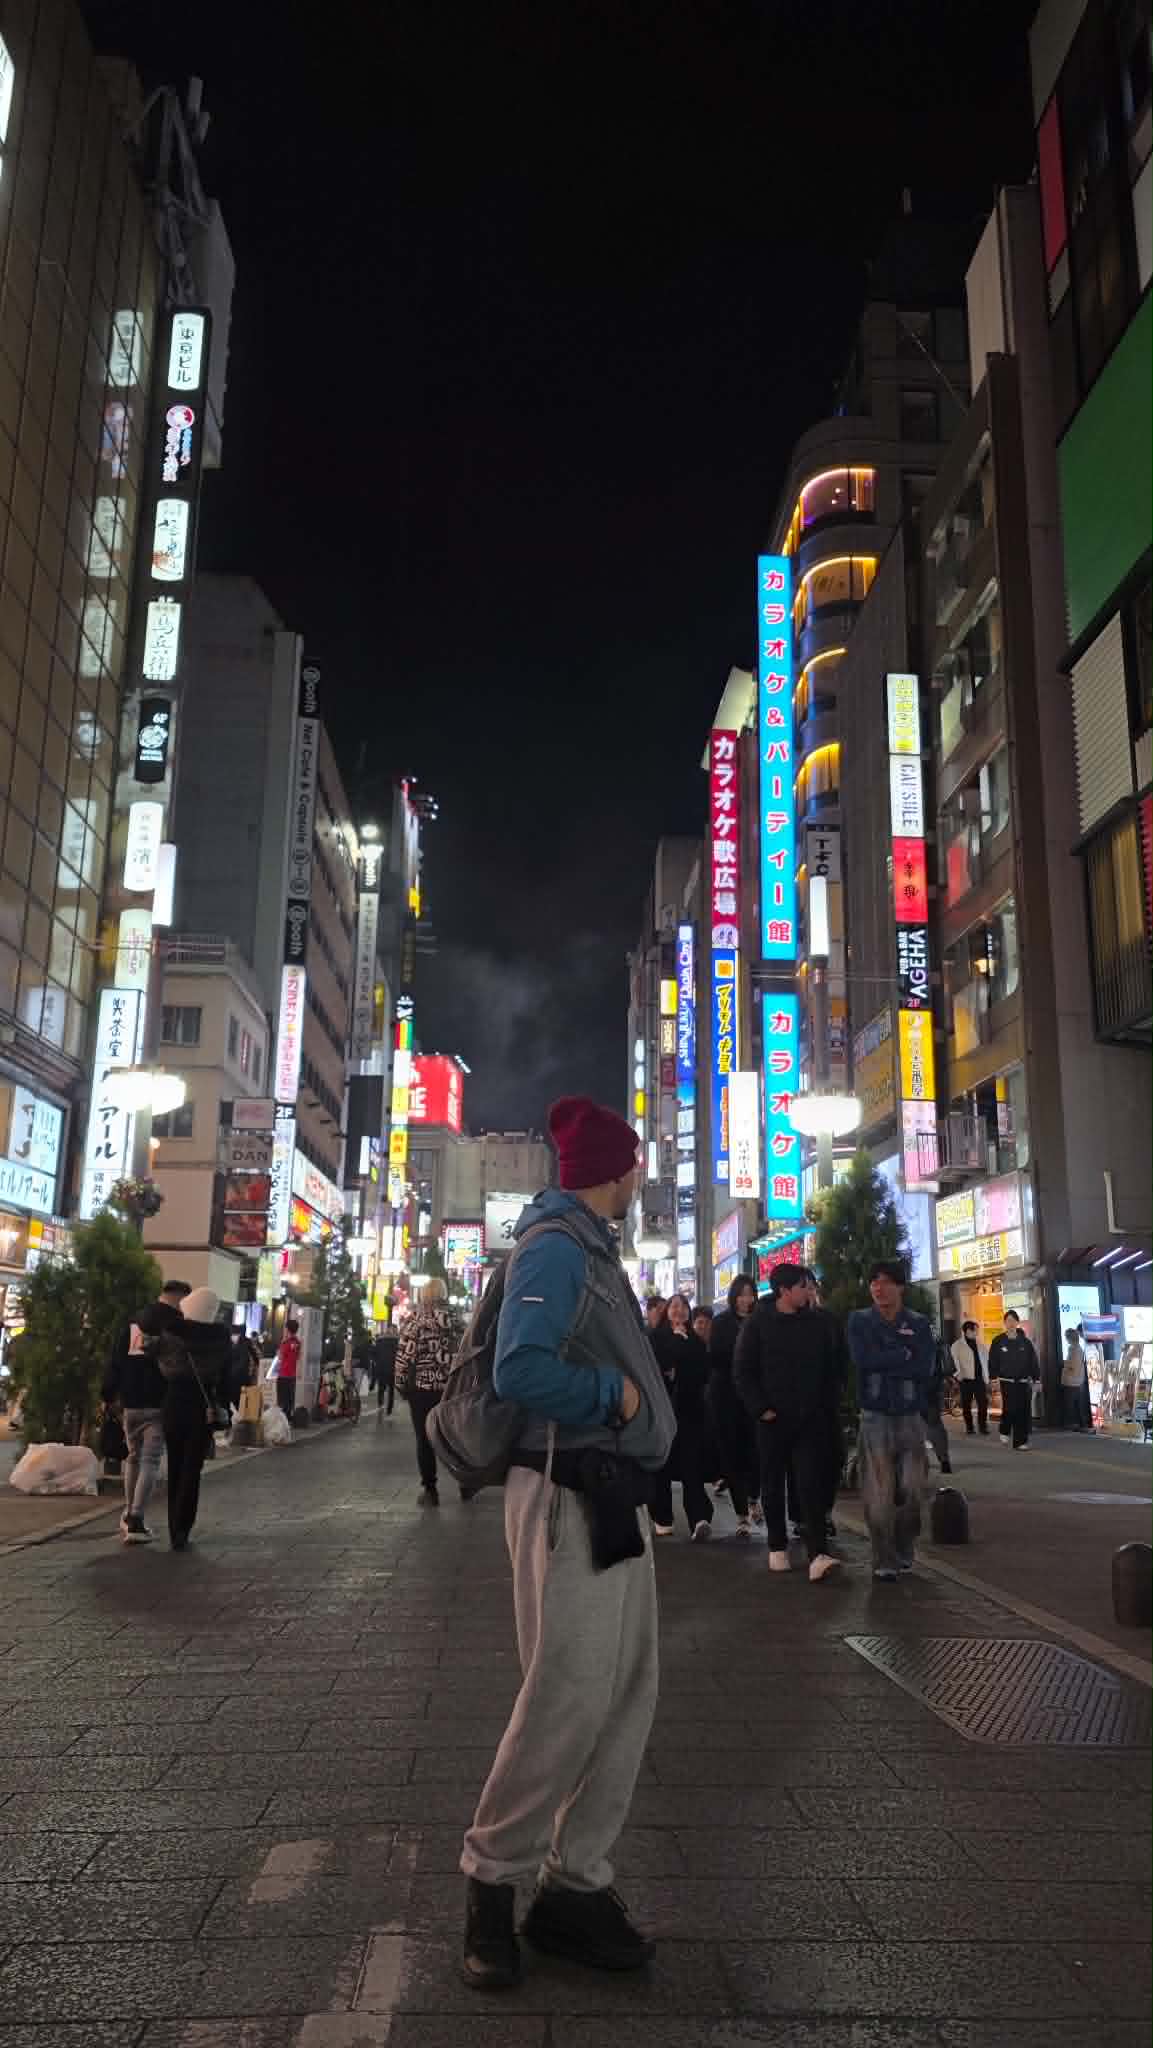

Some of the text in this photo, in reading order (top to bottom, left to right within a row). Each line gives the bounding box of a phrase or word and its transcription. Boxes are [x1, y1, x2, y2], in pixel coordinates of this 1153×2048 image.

[176, 327, 195, 384] 東京ビル
[153, 713, 168, 724] 6F
[713, 736, 737, 915] カラオケ歌広場
[909, 930, 928, 999] AGEHA
[276, 1105, 293, 1118] 2F
[769, 1011, 798, 1201] カラオケ館
